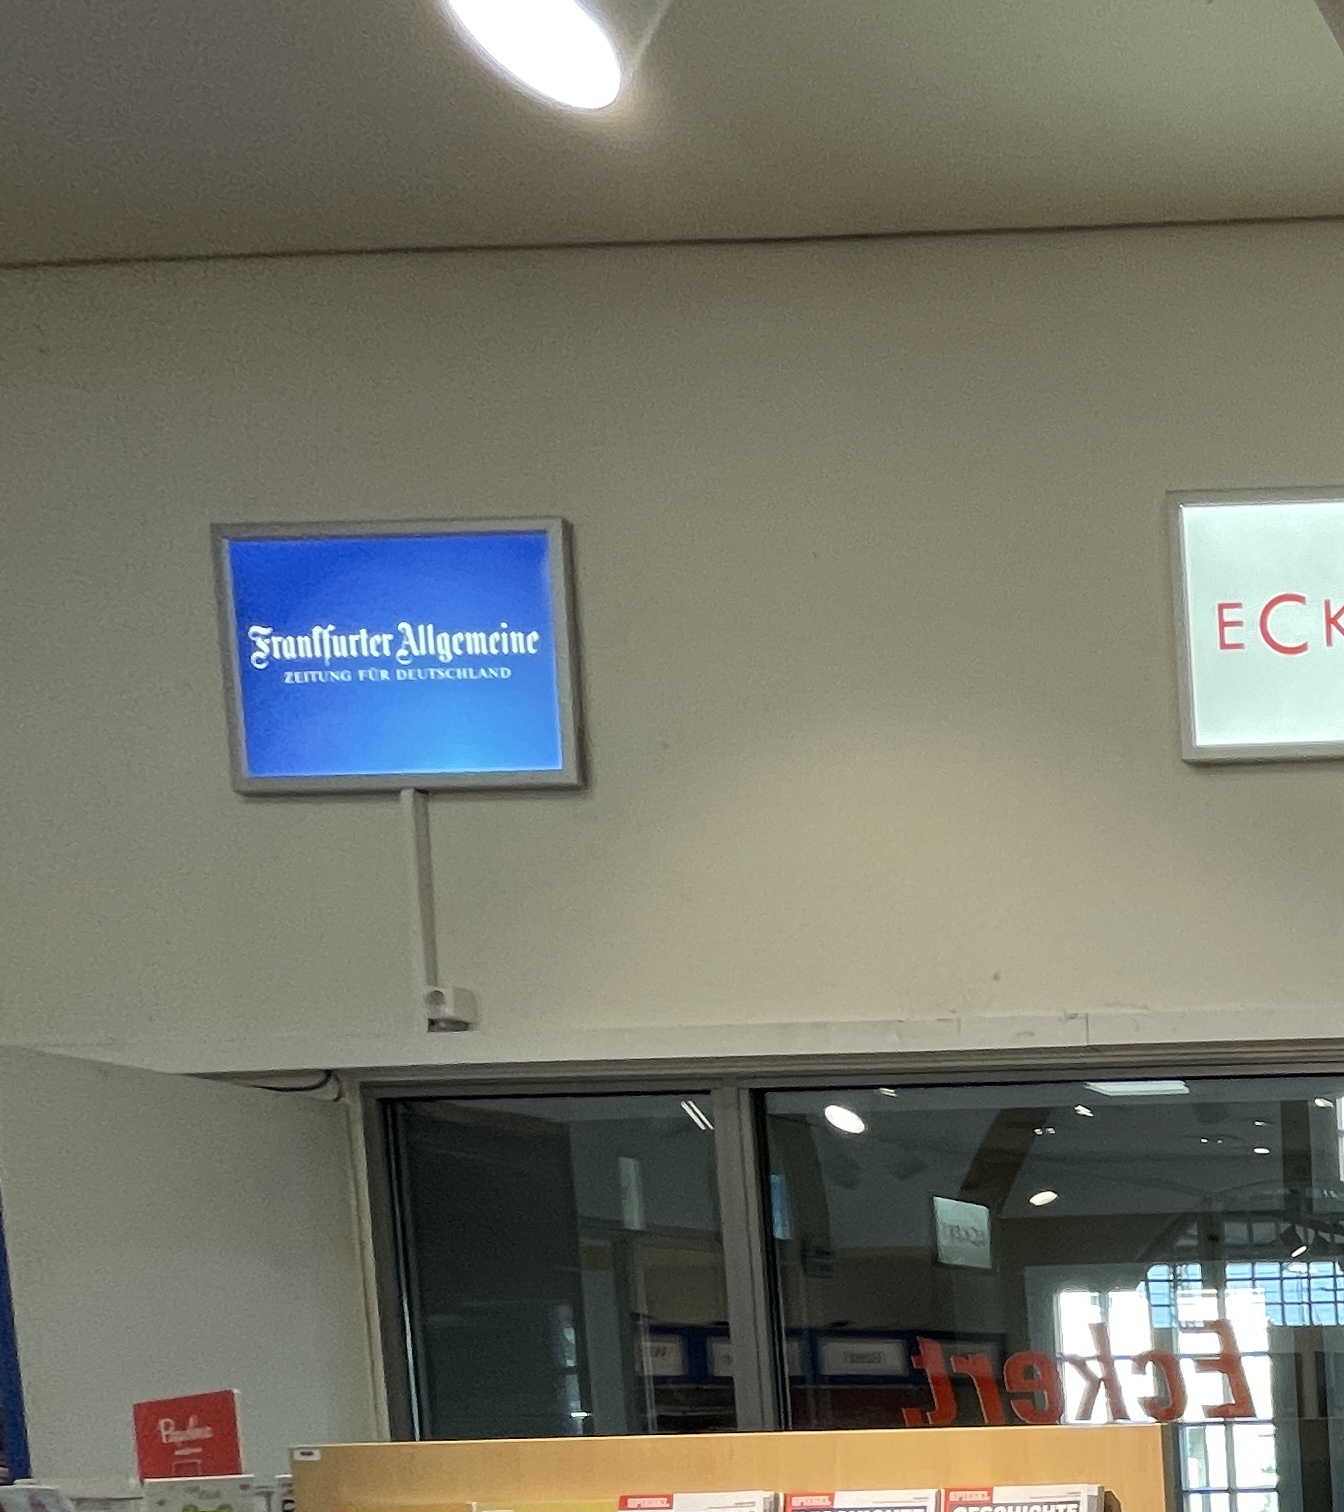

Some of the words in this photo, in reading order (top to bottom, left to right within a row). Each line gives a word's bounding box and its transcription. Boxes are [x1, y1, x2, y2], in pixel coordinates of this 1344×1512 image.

[248, 625, 394, 668] Frankfurter
[395, 621, 539, 664] Allgemeine
[284, 669, 351, 684] ZEITUNG
[359, 667, 390, 682] FÜR
[396, 666, 512, 681] DEUTSCHLAND
